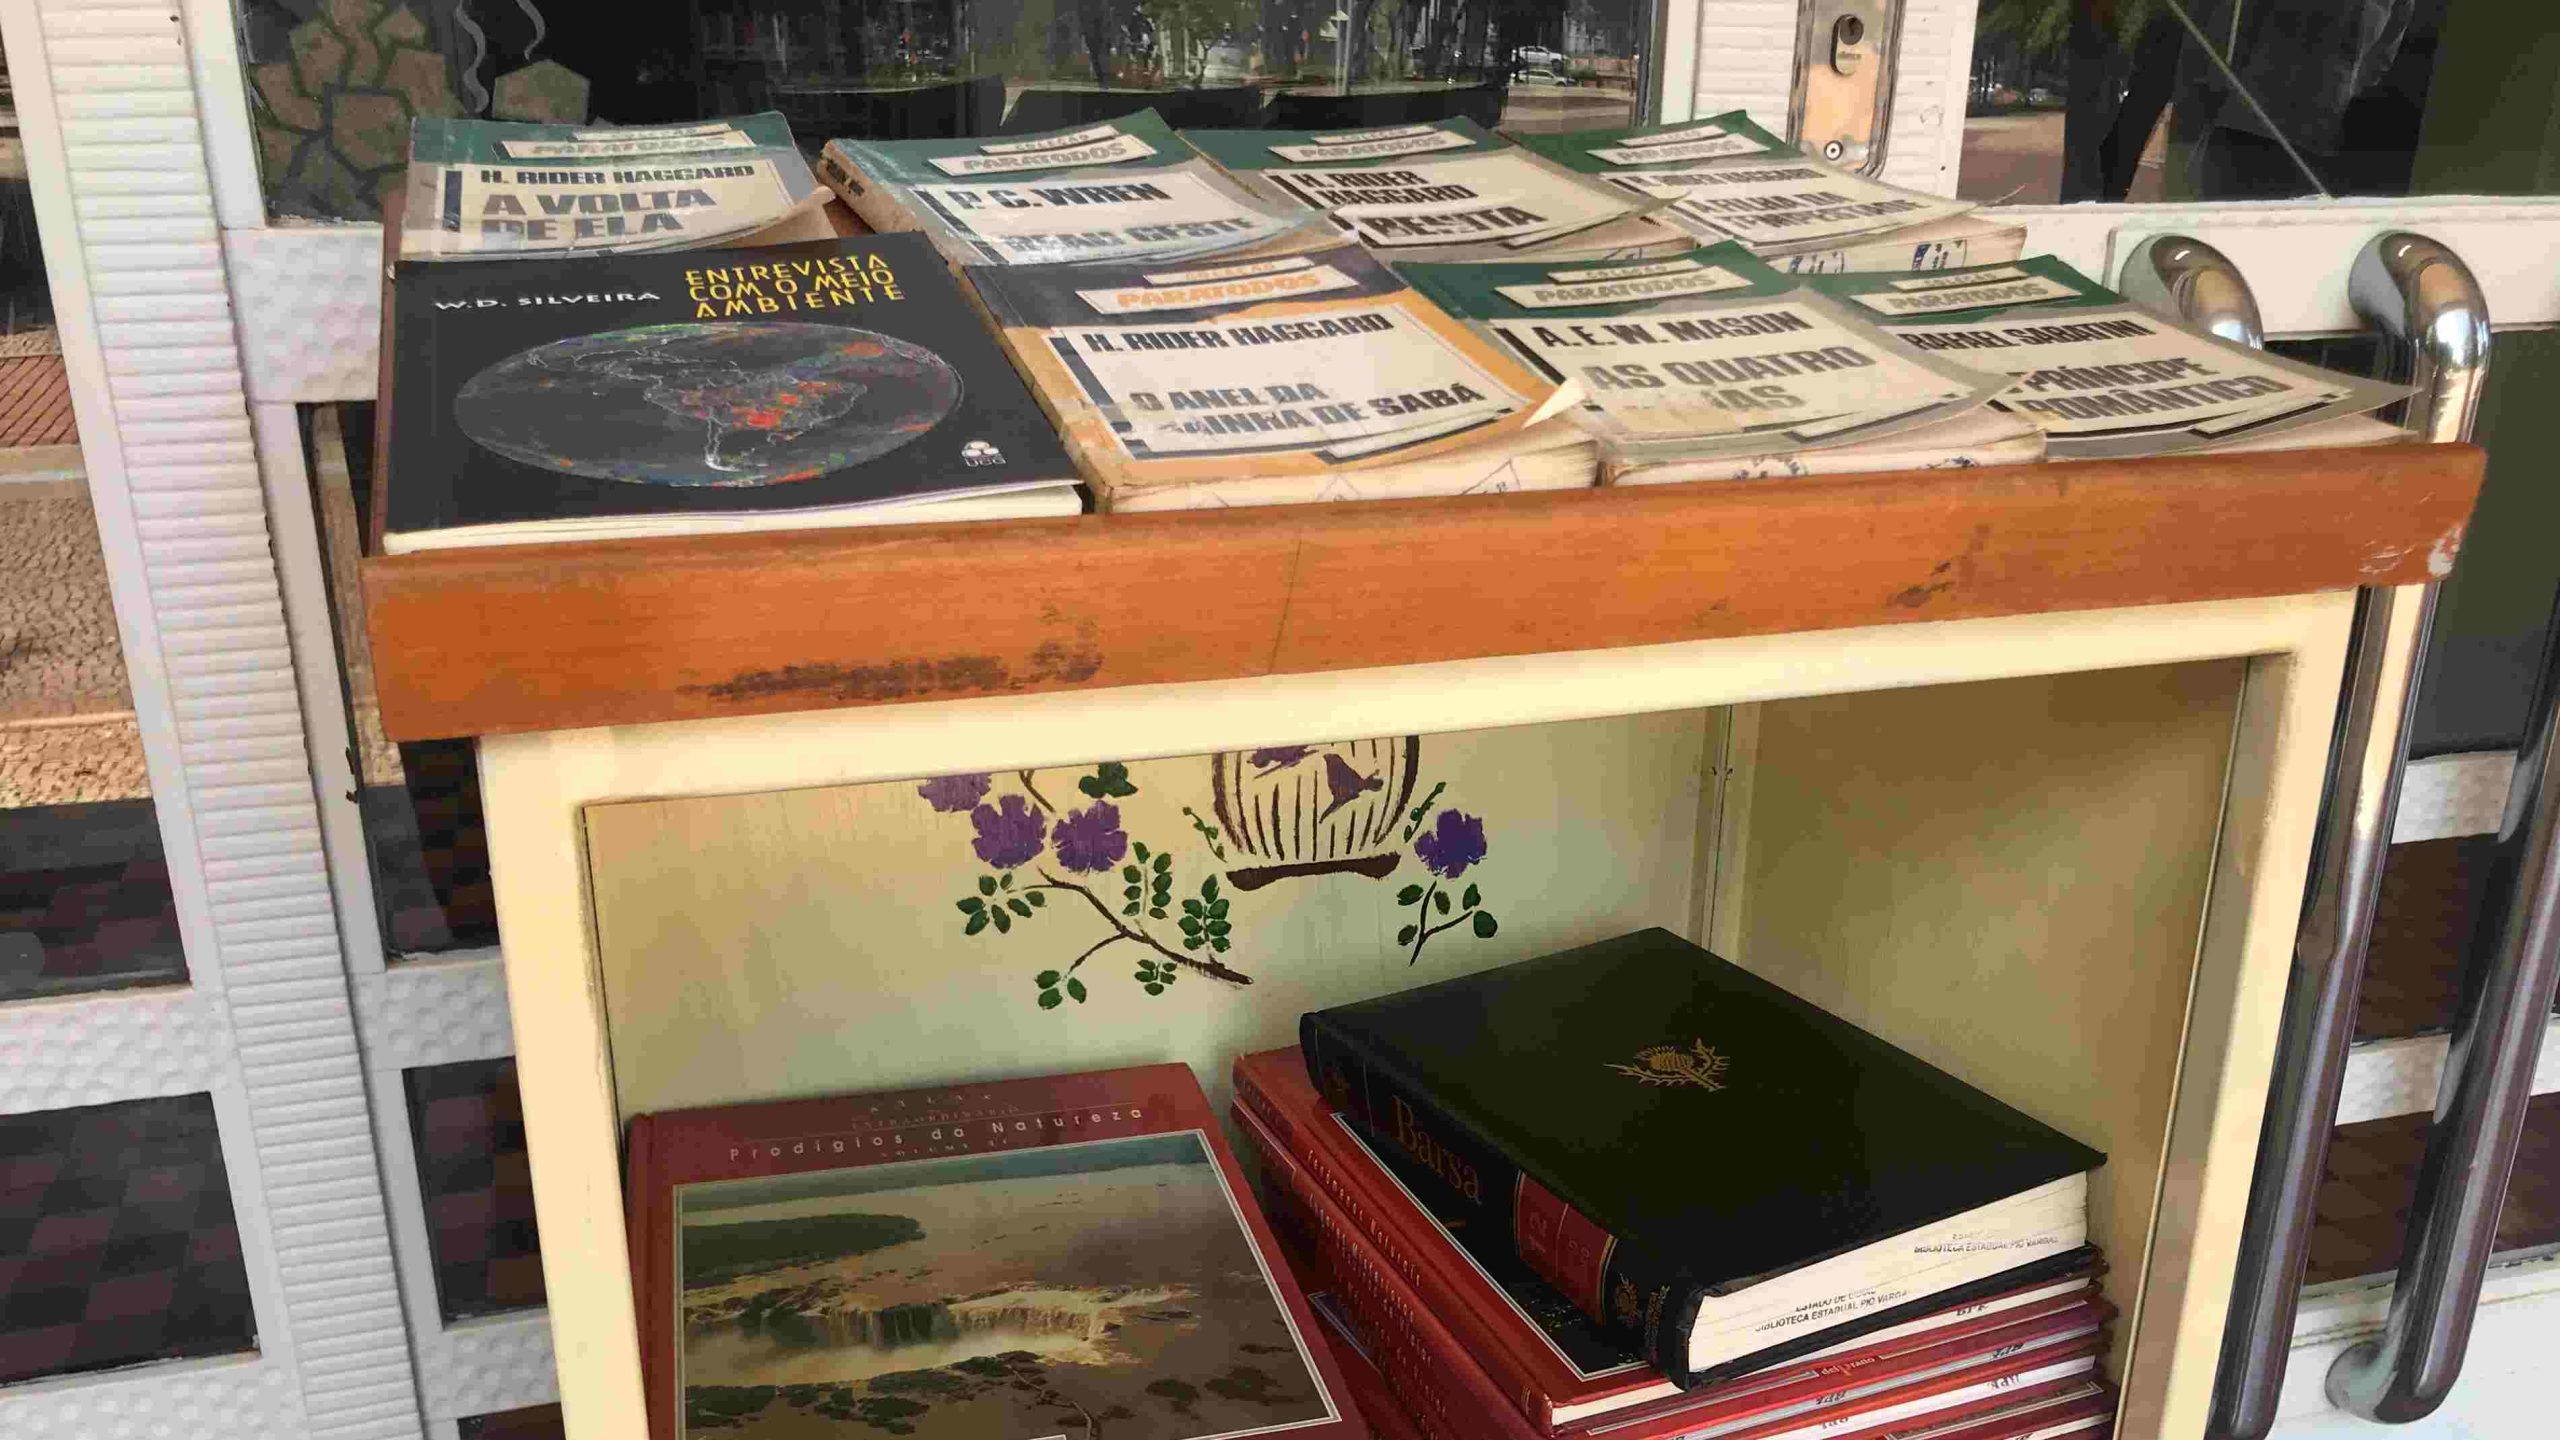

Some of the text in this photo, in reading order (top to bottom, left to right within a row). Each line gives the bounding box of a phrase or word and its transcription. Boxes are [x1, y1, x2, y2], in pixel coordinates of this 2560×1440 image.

[963, 143, 1127, 170] PARATODOS
[481, 165, 754, 184] H. RIDER HAGGARD
[1325, 170, 1430, 187] RIDER
[483, 189, 717, 215] A VOLTA
[1030, 183, 1173, 206] WREN
[1316, 185, 1479, 205] HAGGARD
[574, 213, 683, 239] ELA
[685, 253, 888, 286] ENTREVISTA
[518, 291, 660, 306] SILVEIRA
[689, 269, 894, 301] COM O MEIO
[1116, 273, 1321, 307] PARATODOS
[1534, 275, 1717, 302] PARATODOS
[1886, 283, 2049, 310] PARATODOS
[696, 283, 905, 319] AMBIENTE
[1081, 313, 1395, 352] H. RIDER HAGGARD
[1658, 310, 1815, 342] MASON
[1896, 319, 2158, 350] RAFAEL SABATINI
[1581, 345, 1879, 390] AS QUATRO
[1129, 382, 1330, 412] O ANEL DA
[1310, 402, 1370, 424] DE
[1368, 381, 1487, 416] SABÁ
[931, 1127, 965, 1140] da
[992, 1108, 1143, 1134] Natureza
[1393, 1095, 1482, 1206] Barsa
